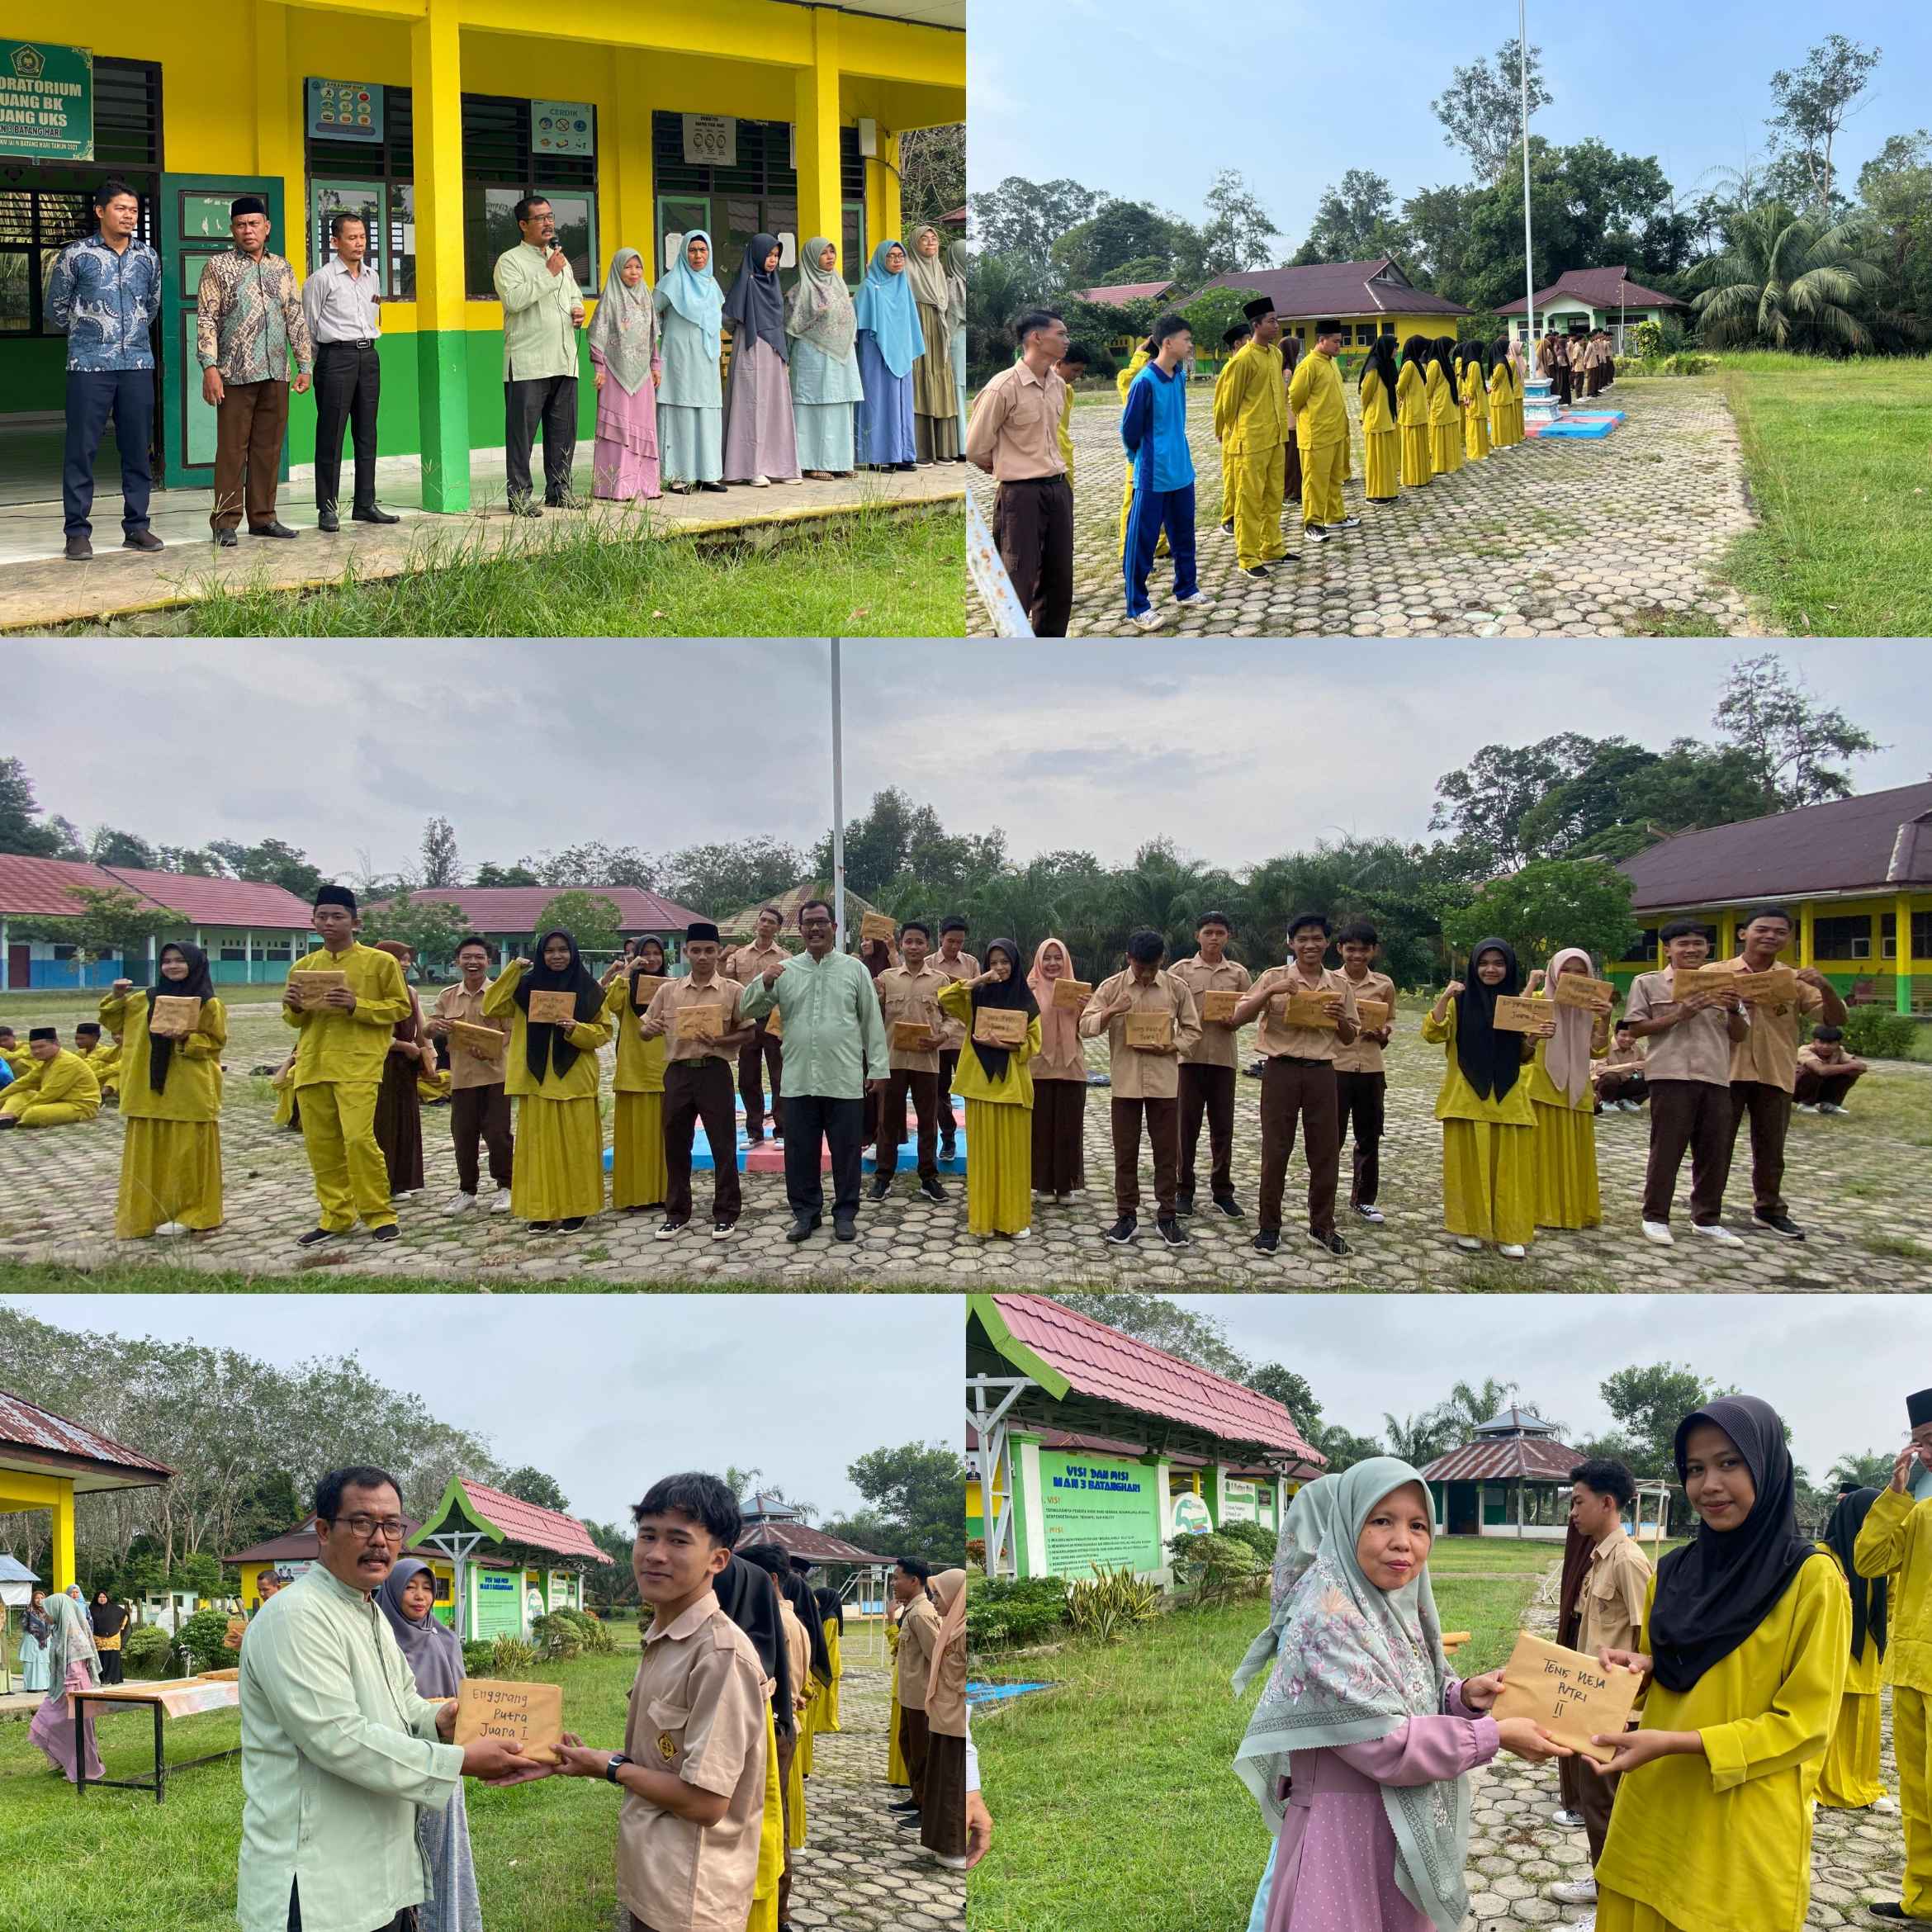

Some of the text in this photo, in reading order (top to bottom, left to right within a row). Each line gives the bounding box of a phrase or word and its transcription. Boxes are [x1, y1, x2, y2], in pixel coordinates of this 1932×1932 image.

[43, 97, 64, 111] BK
[39, 112, 67, 127] UKS
[549, 108, 578, 116] CERDIK
[14, 125, 44, 135] BATANG
[45, 128, 62, 138] HARI
[1066, 1465, 1129, 1481] VISI DAN MISI
[1053, 1476, 1140, 1493] MAN 3 BATANGHARI
[1047, 1496, 1060, 1504] VISI
[1577, 1670, 1606, 1689] MEJA
[472, 1688, 528, 1708] Enggrang
[1558, 1681, 1587, 1702] PUTRI
[494, 1708, 528, 1723] Putra
[480, 1722, 515, 1737] Juara
